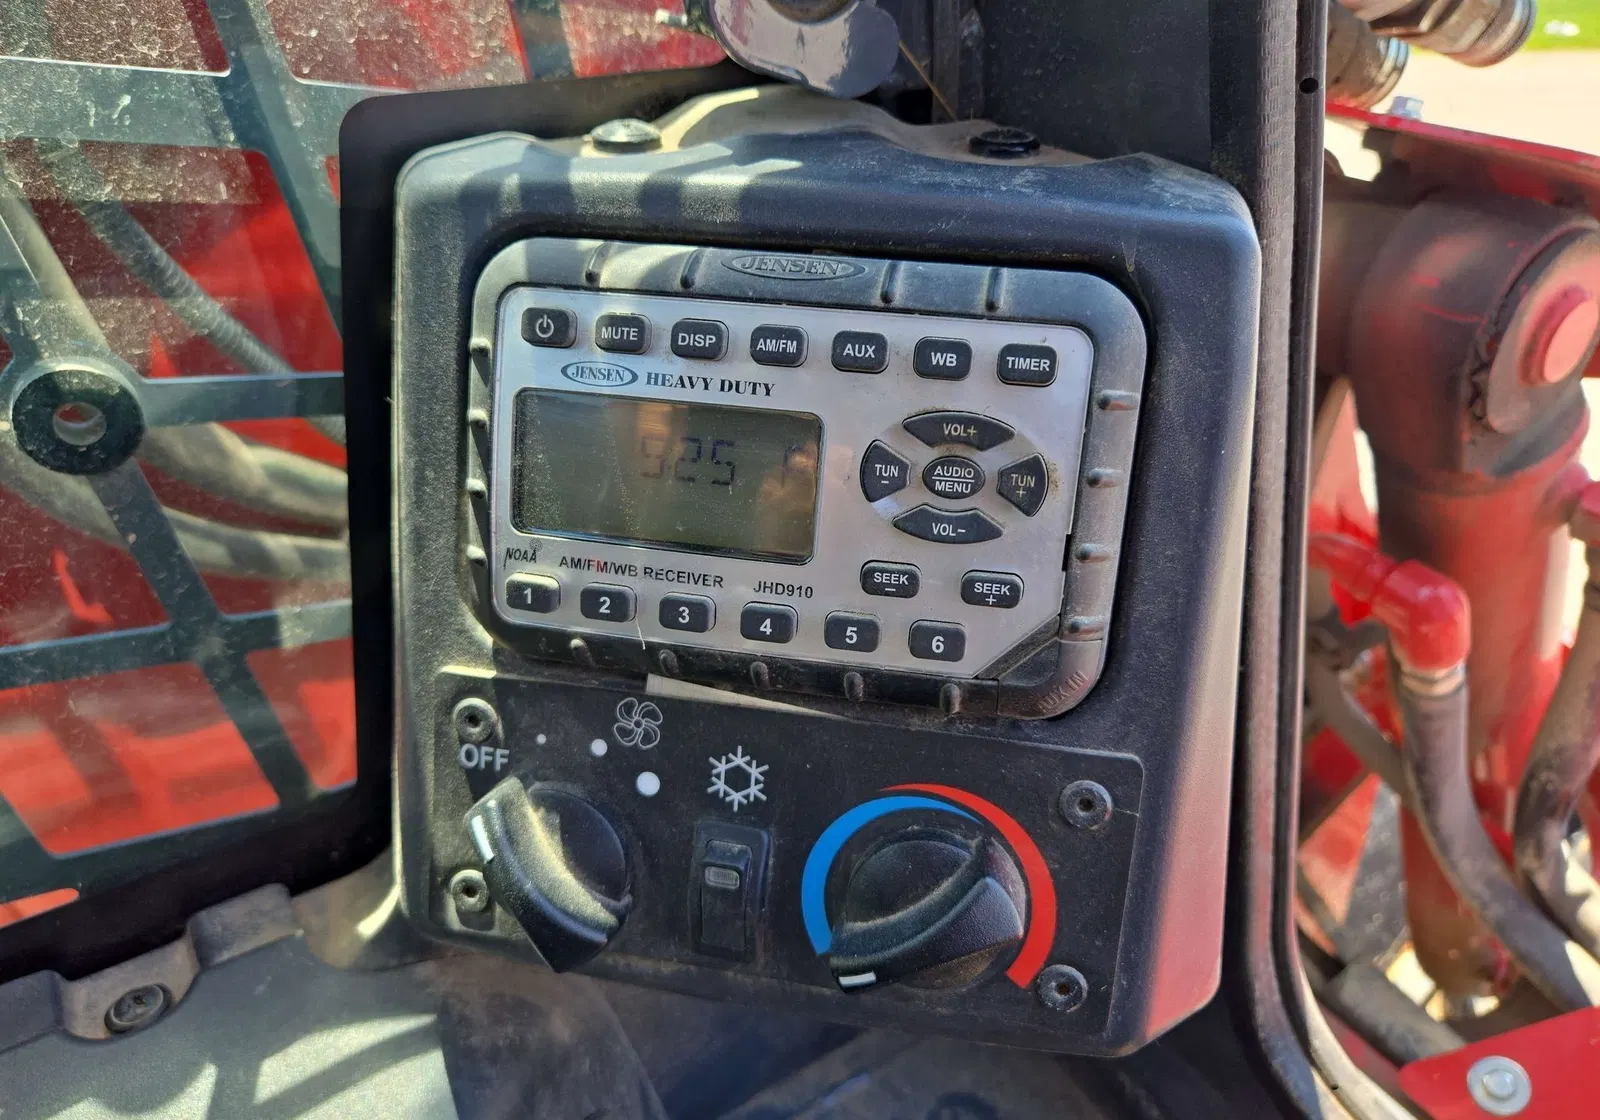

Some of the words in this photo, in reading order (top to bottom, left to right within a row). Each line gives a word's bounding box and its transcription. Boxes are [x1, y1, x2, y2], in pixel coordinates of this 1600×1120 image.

[741, 257, 841, 276] JENSEN
[600, 326, 639, 342] MUTE
[677, 332, 717, 348] DISP
[756, 340, 797, 354] AM/FM
[842, 343, 876, 359] AUX
[930, 351, 957, 368] WB
[1005, 356, 1051, 372] TIMER
[570, 363, 626, 384] JENSEN
[645, 371, 714, 391] HEAVY
[719, 379, 776, 397] DUTY
[943, 422, 977, 438] VOL+
[874, 463, 899, 478] TUN
[933, 465, 975, 479] AUDIO
[934, 480, 972, 494] MENU
[1010, 473, 1036, 487] TUN
[503, 547, 538, 571] NOAA
[558, 555, 638, 578] AM/FM/WB
[643, 567, 724, 589] RECEIVER
[873, 571, 909, 586] SEEK
[522, 588, 533, 605] 1
[752, 580, 814, 600] JHD910
[973, 581, 1011, 596] SEEK
[598, 597, 611, 614] 2
[677, 607, 690, 624] 3
[758, 618, 772, 635] 4
[845, 626, 858, 644] 5
[931, 636, 945, 653] 6
[459, 743, 510, 772] OFF
